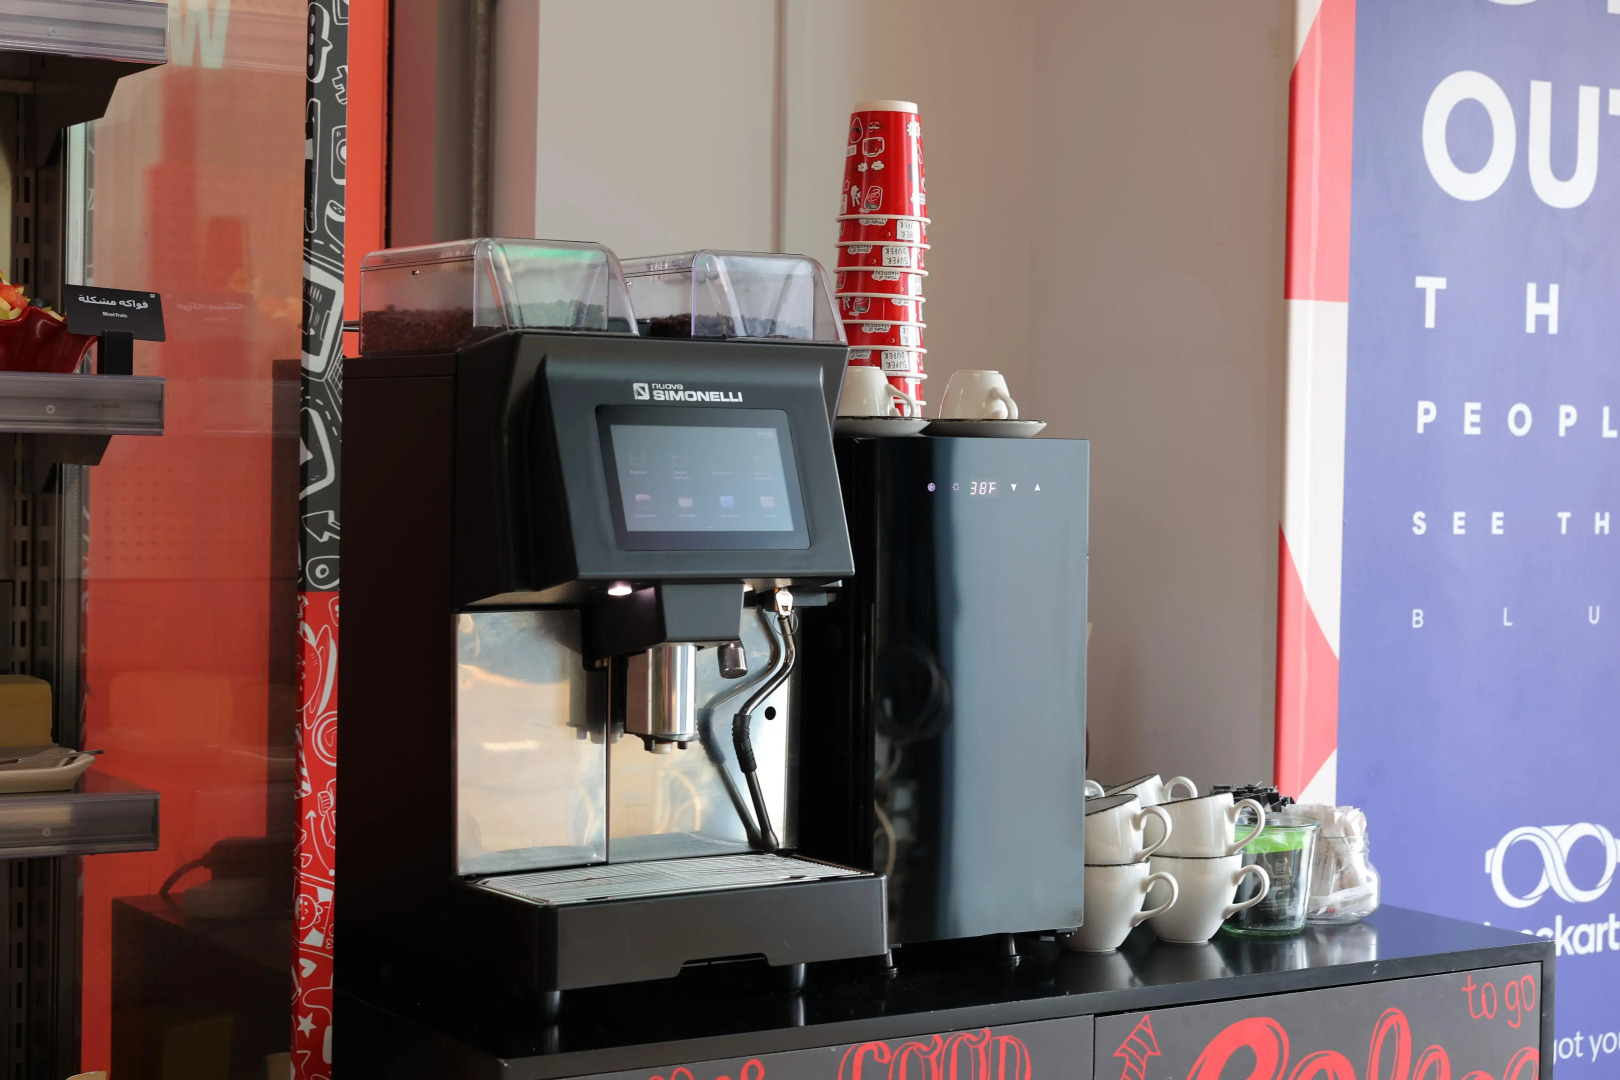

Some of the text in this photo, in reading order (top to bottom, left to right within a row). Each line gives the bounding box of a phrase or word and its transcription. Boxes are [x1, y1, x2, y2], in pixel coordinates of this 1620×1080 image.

[78, 294, 149, 310] فواكه مشكلة
[652, 390, 743, 403] SIMONELLI
[1417, 400, 1618, 438] PEOPL
[970, 481, 997, 495] 38F
[1412, 511, 1610, 535] SEE TH
[1461, 975, 1536, 1028] to go
[1589, 1032, 1620, 1063] yo
